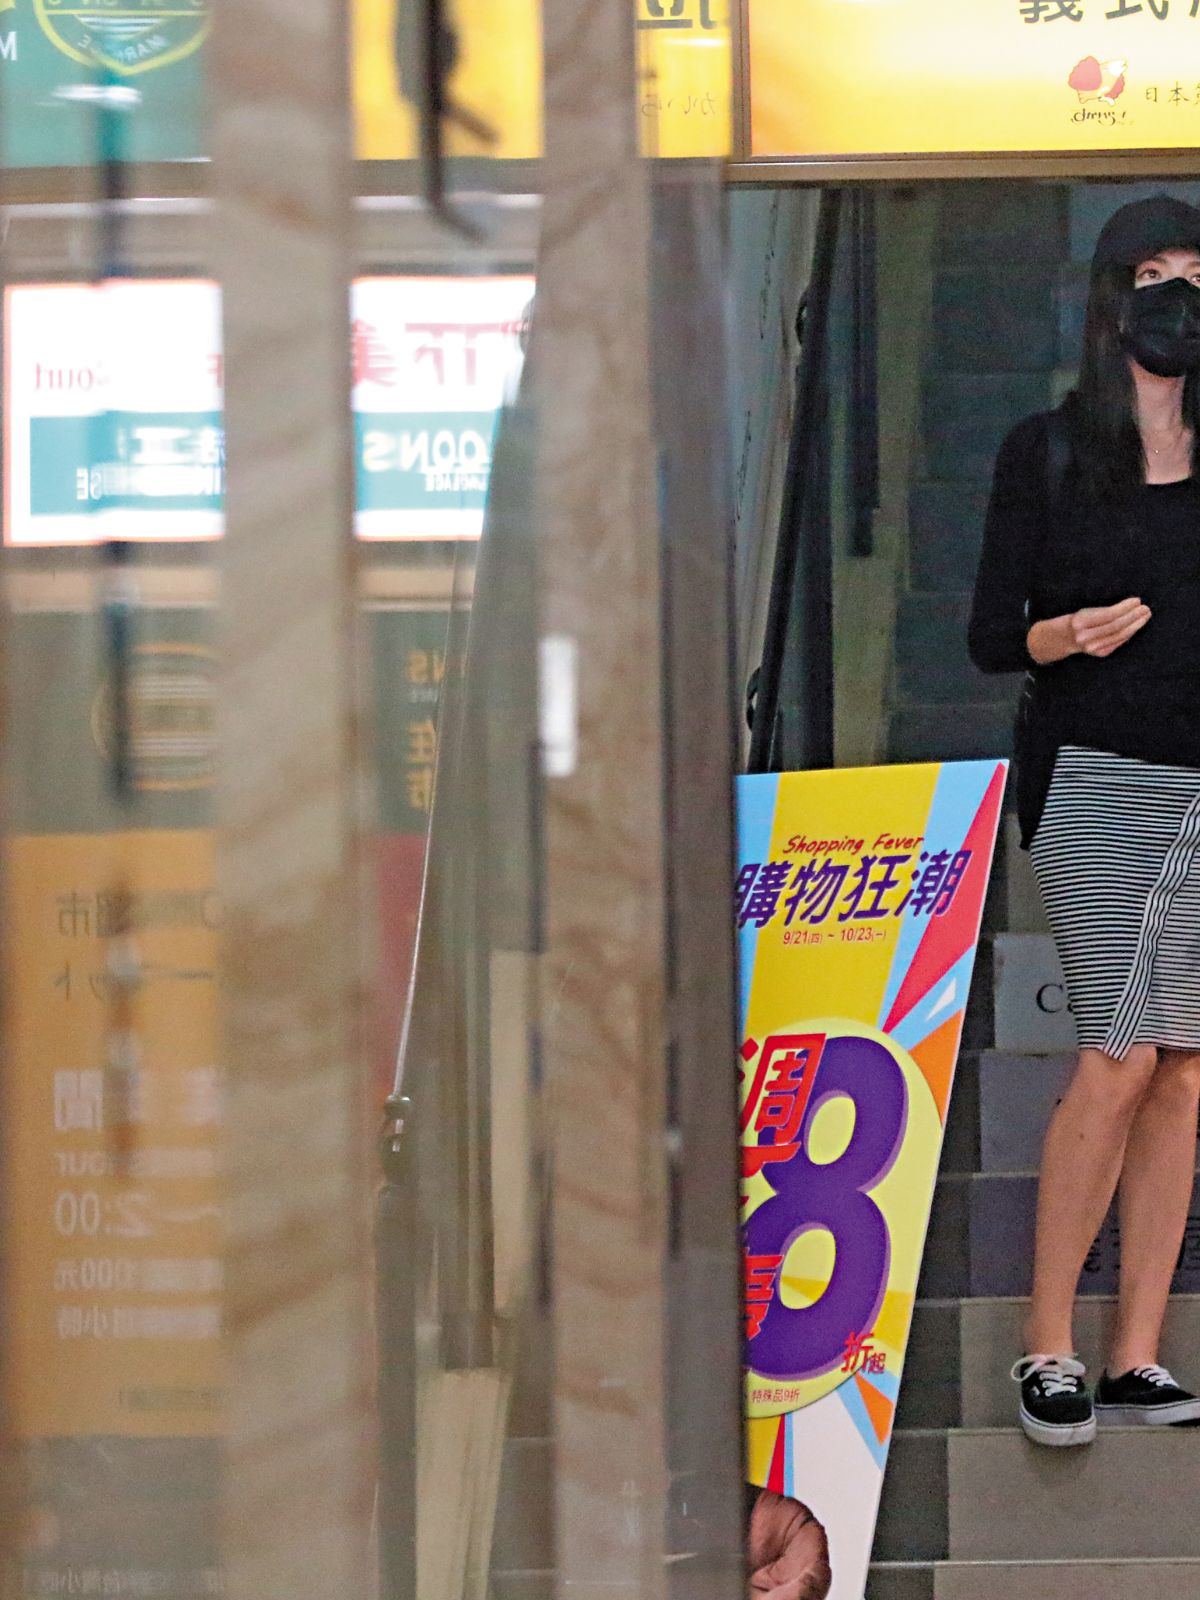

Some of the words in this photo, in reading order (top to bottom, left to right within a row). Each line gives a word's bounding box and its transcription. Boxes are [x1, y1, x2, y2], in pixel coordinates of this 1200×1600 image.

[782, 834, 865, 856] Shopping
[872, 832, 925, 852] Fever
[738, 849, 972, 930] 購物狂潮
